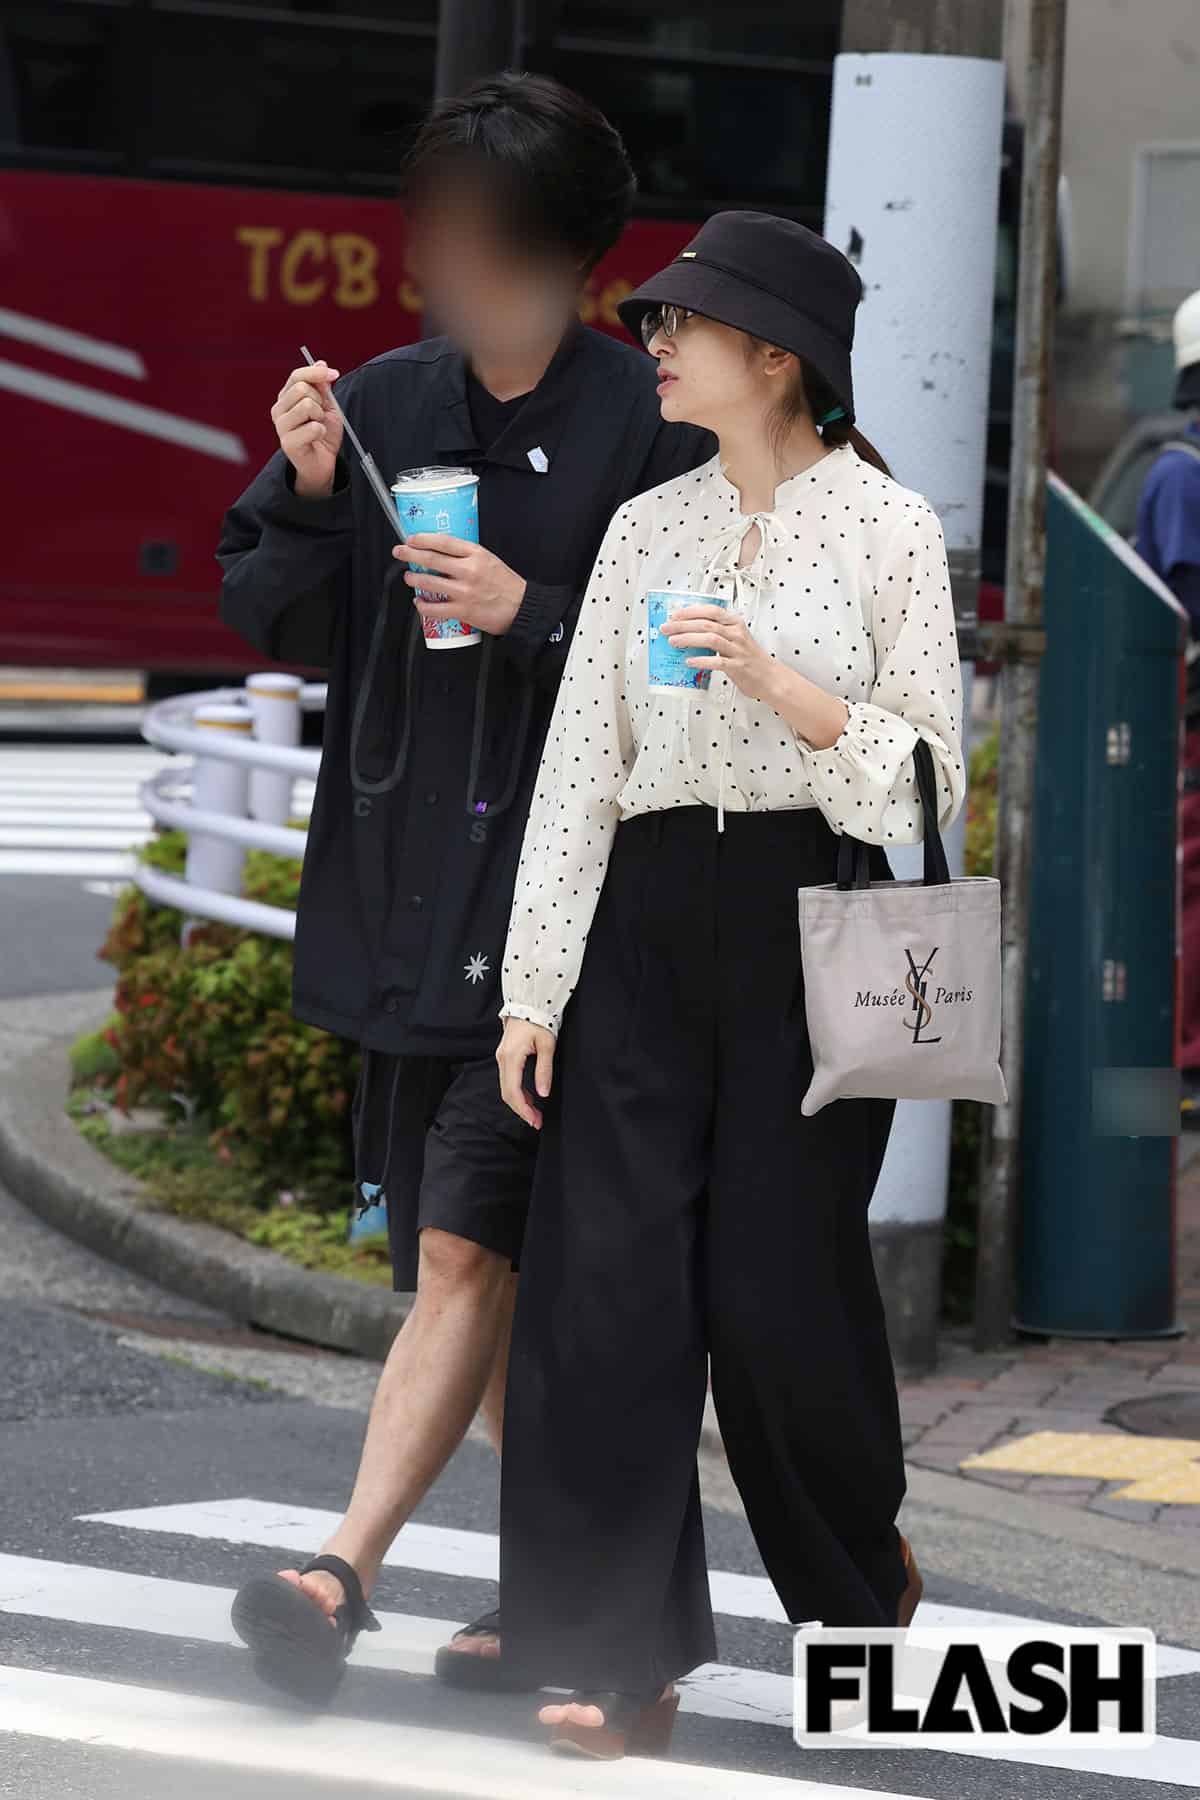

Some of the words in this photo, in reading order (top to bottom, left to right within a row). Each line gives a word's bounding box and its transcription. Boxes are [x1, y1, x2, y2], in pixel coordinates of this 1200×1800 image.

[236, 227, 378, 309] TCB
[854, 988, 906, 1008] Musée
[903, 947, 942, 1043] YSL
[934, 986, 973, 1004] Paris
